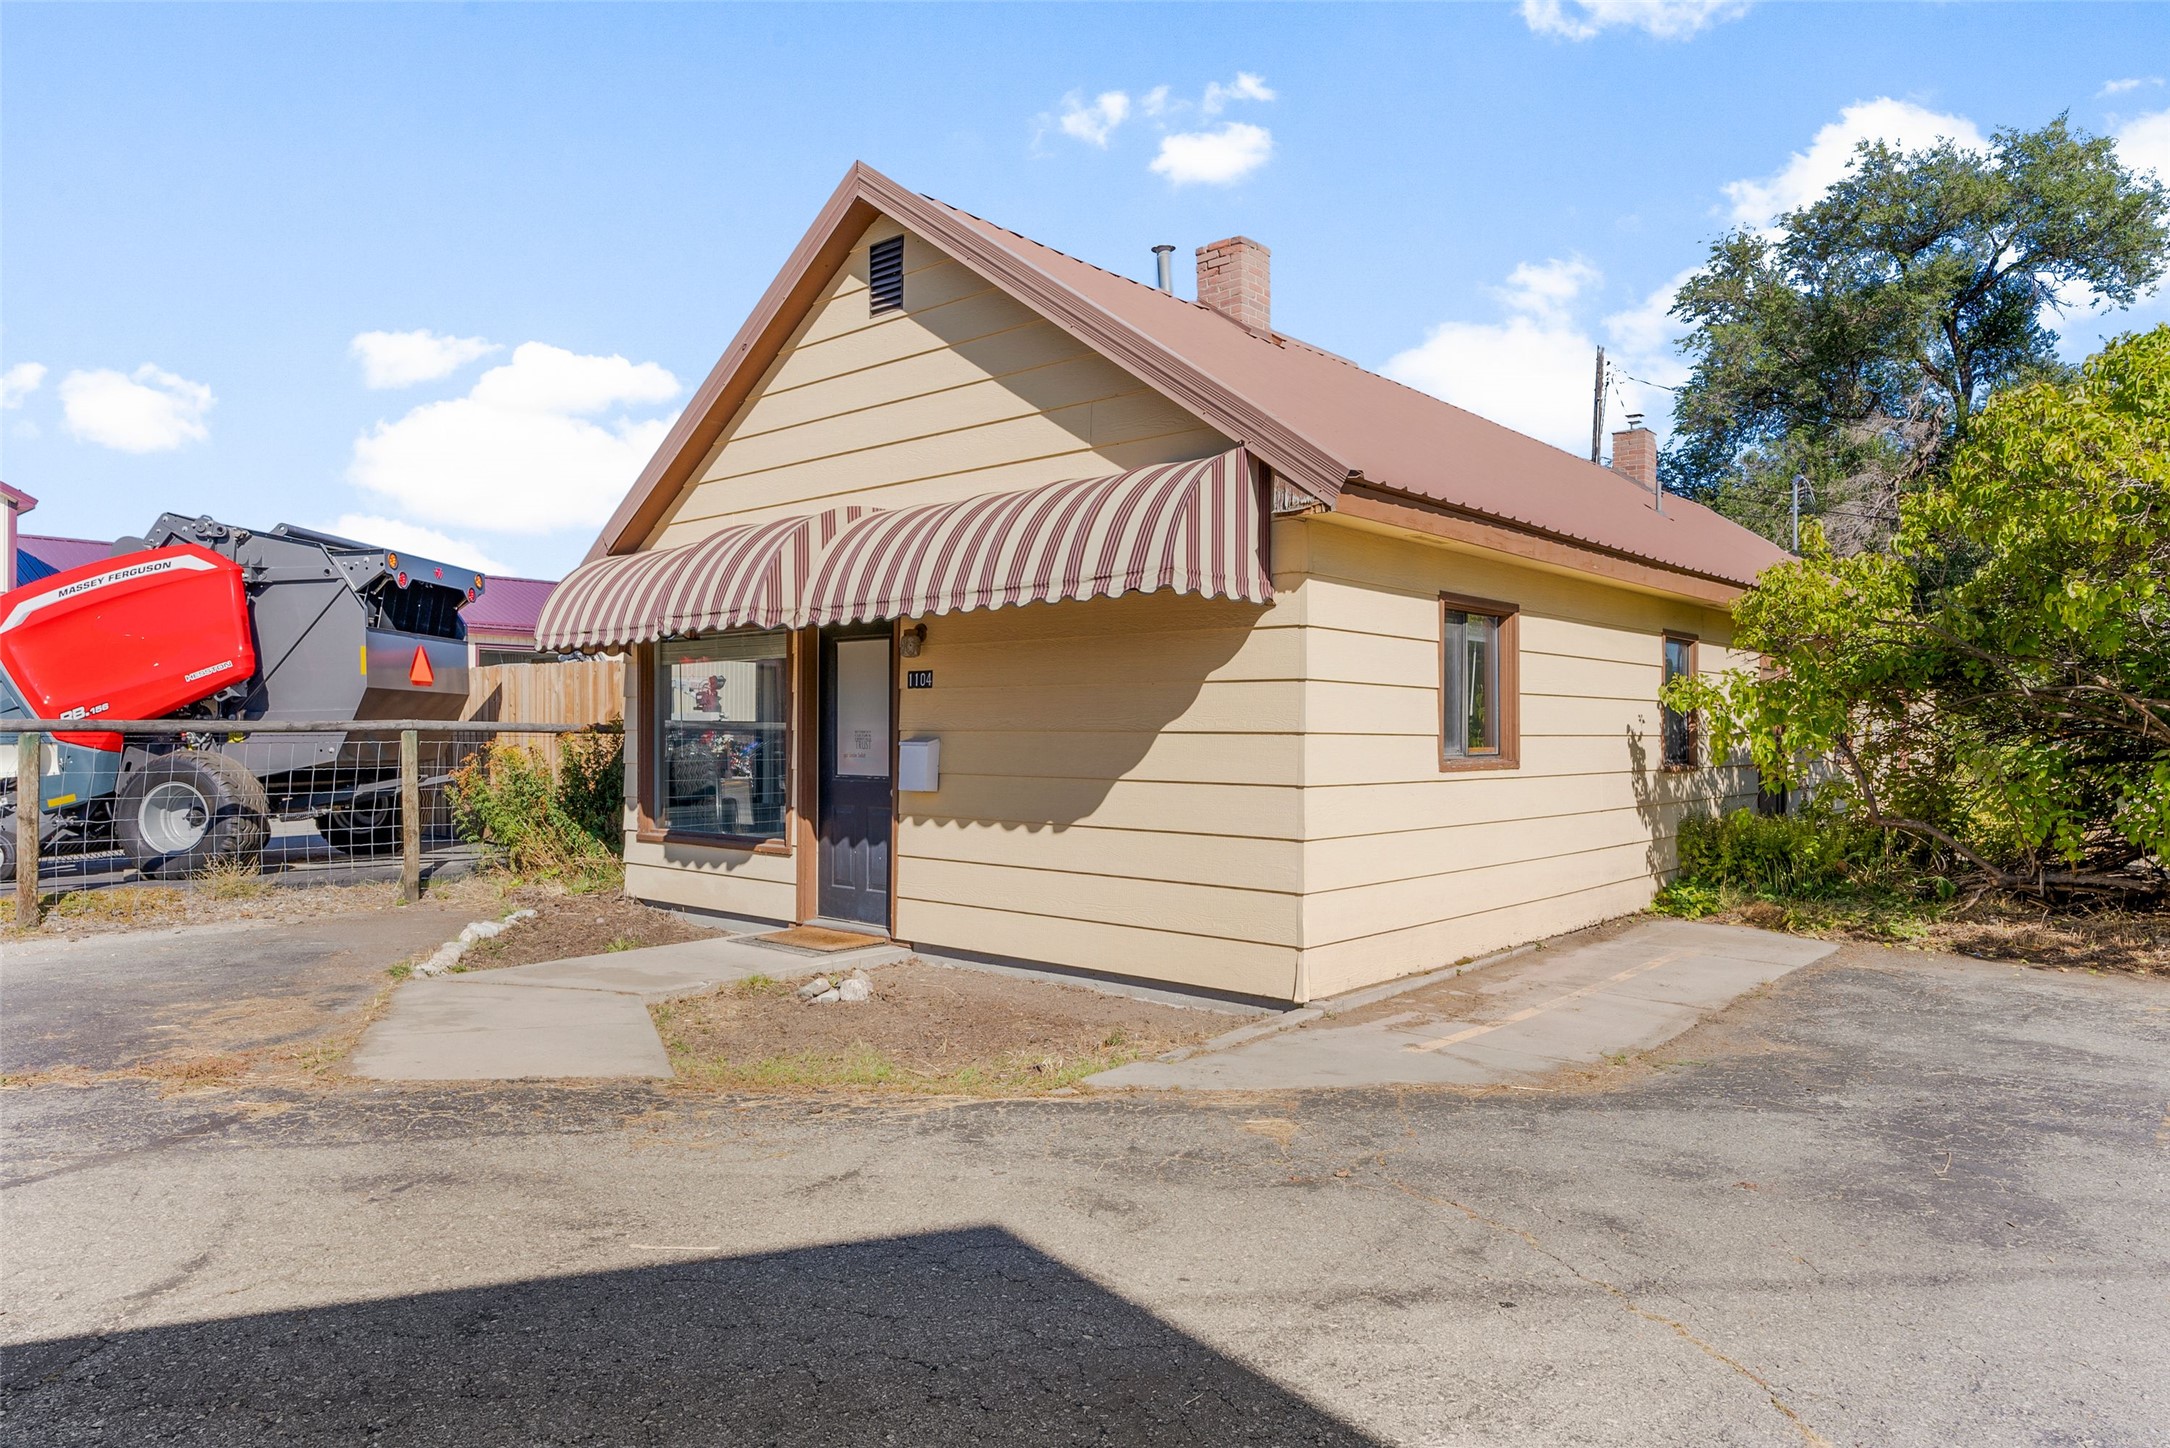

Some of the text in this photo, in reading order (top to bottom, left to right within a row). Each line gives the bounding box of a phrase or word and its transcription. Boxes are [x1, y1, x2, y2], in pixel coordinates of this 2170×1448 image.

[58, 561, 172, 598] MASSEY FERGUSON
[909, 672, 932, 687] 1104
